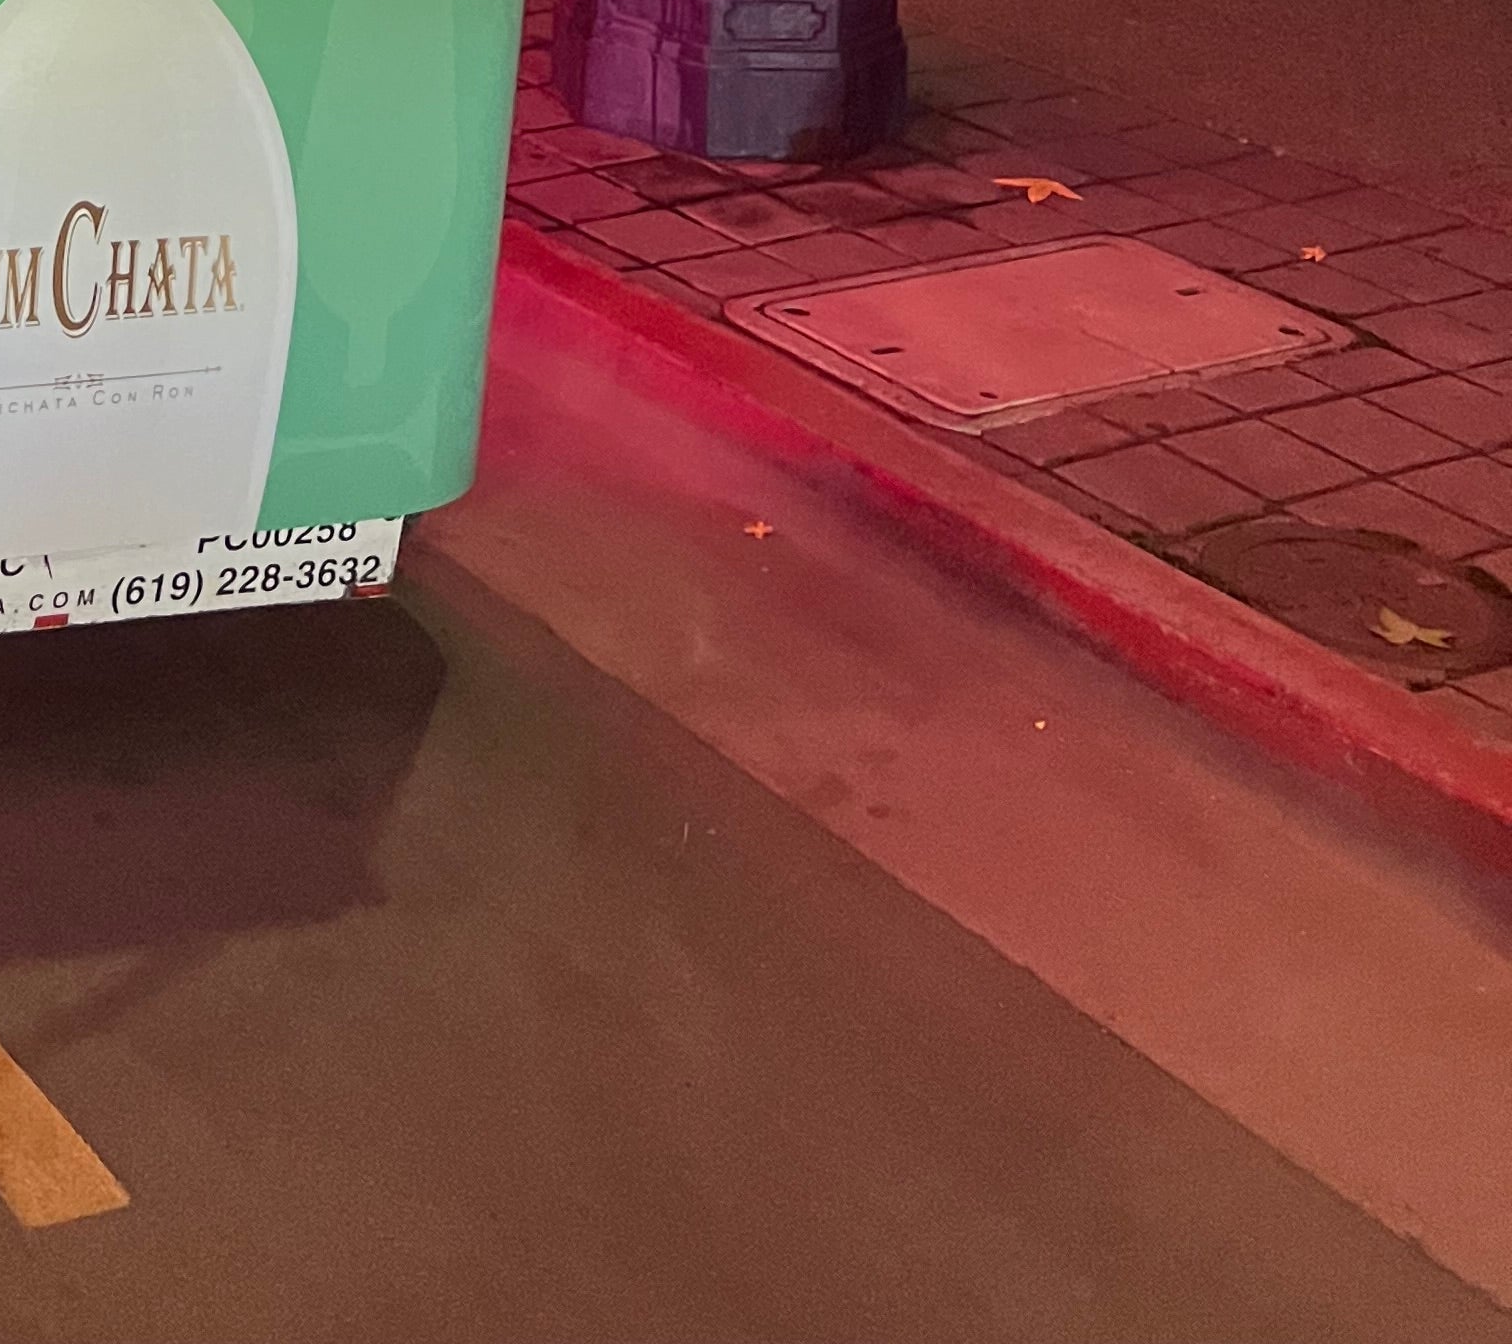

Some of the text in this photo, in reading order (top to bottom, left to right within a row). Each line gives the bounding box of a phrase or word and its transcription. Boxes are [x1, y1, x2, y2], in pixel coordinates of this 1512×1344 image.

[92, 389, 138, 406] CON
[152, 384, 194, 400] RON
[111, 569, 204, 614] (619)
[215, 555, 380, 596] 228-3632
